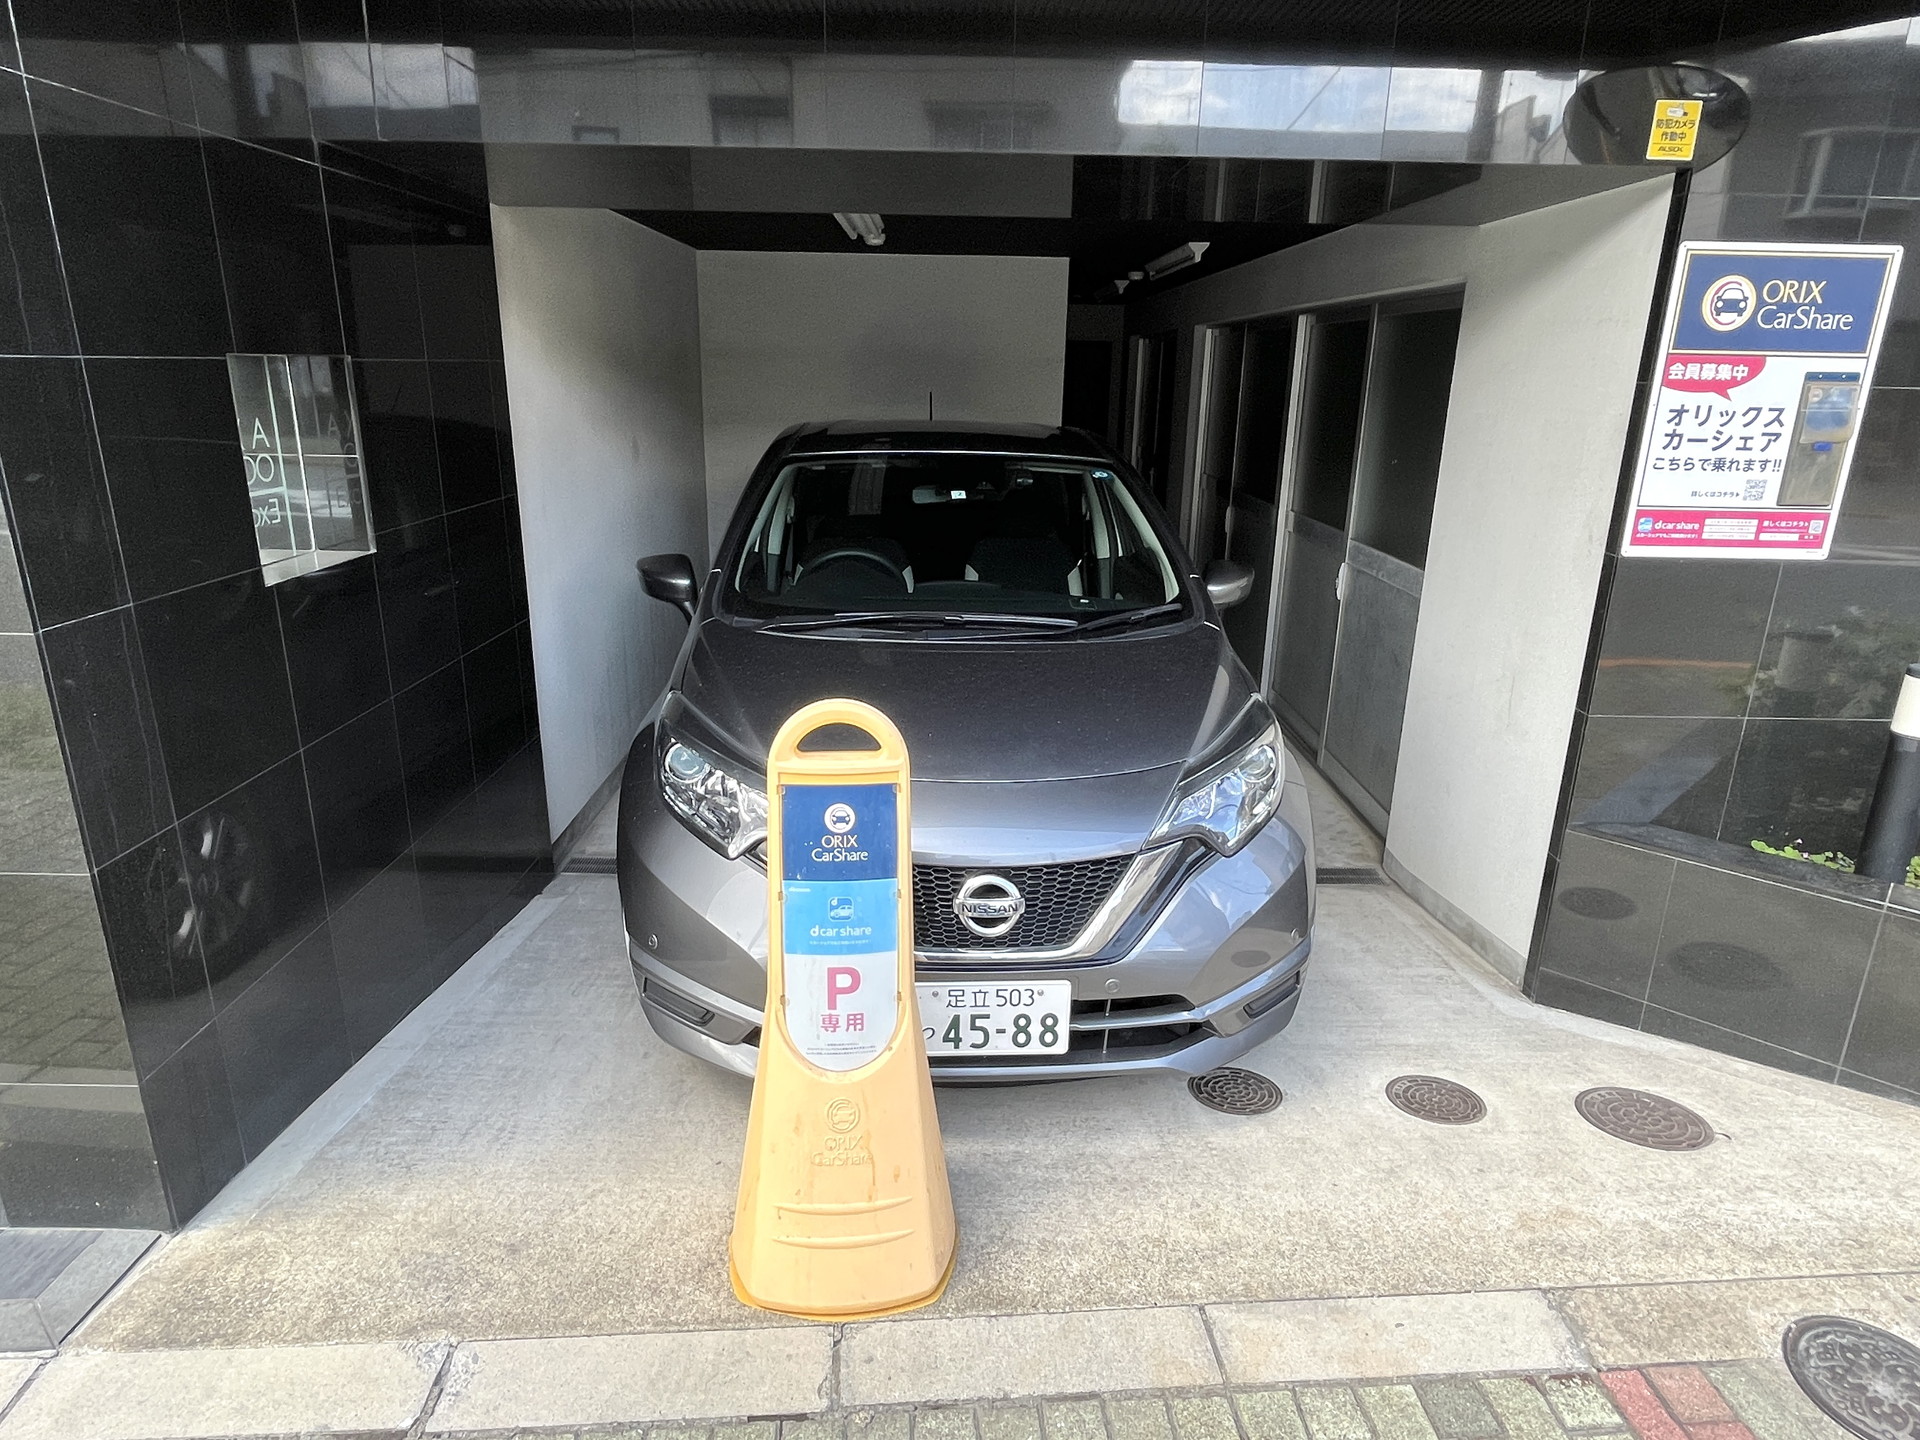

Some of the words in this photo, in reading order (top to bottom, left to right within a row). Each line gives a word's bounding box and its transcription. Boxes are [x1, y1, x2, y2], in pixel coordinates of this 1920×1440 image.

[1762, 280, 1826, 304] ORIX
[1757, 306, 1854, 331] CarShare
[1668, 362, 1749, 381] 会員募集中
[1666, 404, 1786, 428] オリックス
[1662, 428, 1782, 453] カーシェア
[1652, 457, 1782, 473] こちらで乗れます!!
[821, 834, 858, 848] ORIX
[811, 848, 869, 862] CarShare
[961, 904, 1019, 915] NISSAN
[840, 926, 872, 936] share
[826, 966, 862, 1011] P
[820, 1013, 865, 1033] 専用
[942, 1012, 1059, 1049] 45-88
